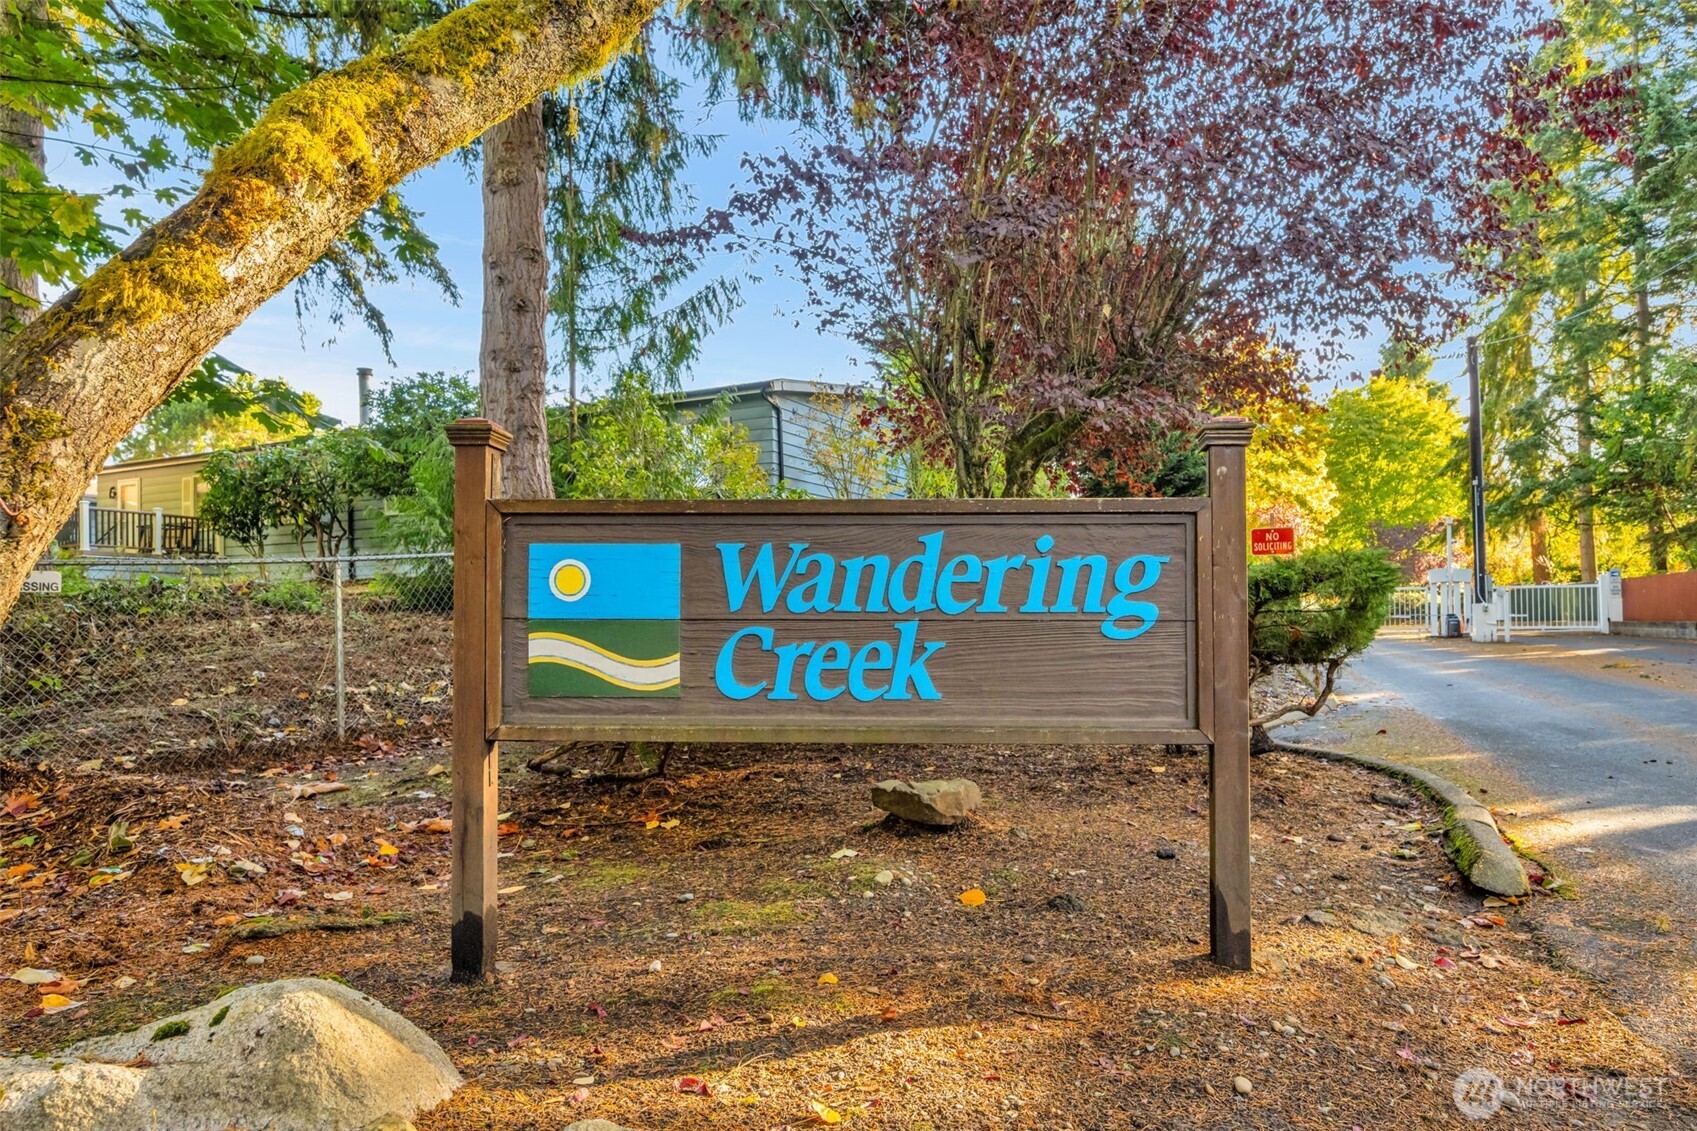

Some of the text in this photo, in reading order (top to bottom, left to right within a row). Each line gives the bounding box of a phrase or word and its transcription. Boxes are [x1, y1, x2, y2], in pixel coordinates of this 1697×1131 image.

[1265, 532, 1280, 541] NO
[1253, 541, 1293, 552] SOLICITING
[20, 581, 59, 592] SSING
[715, 531, 1170, 640] Wandering
[714, 619, 946, 701] Creek
